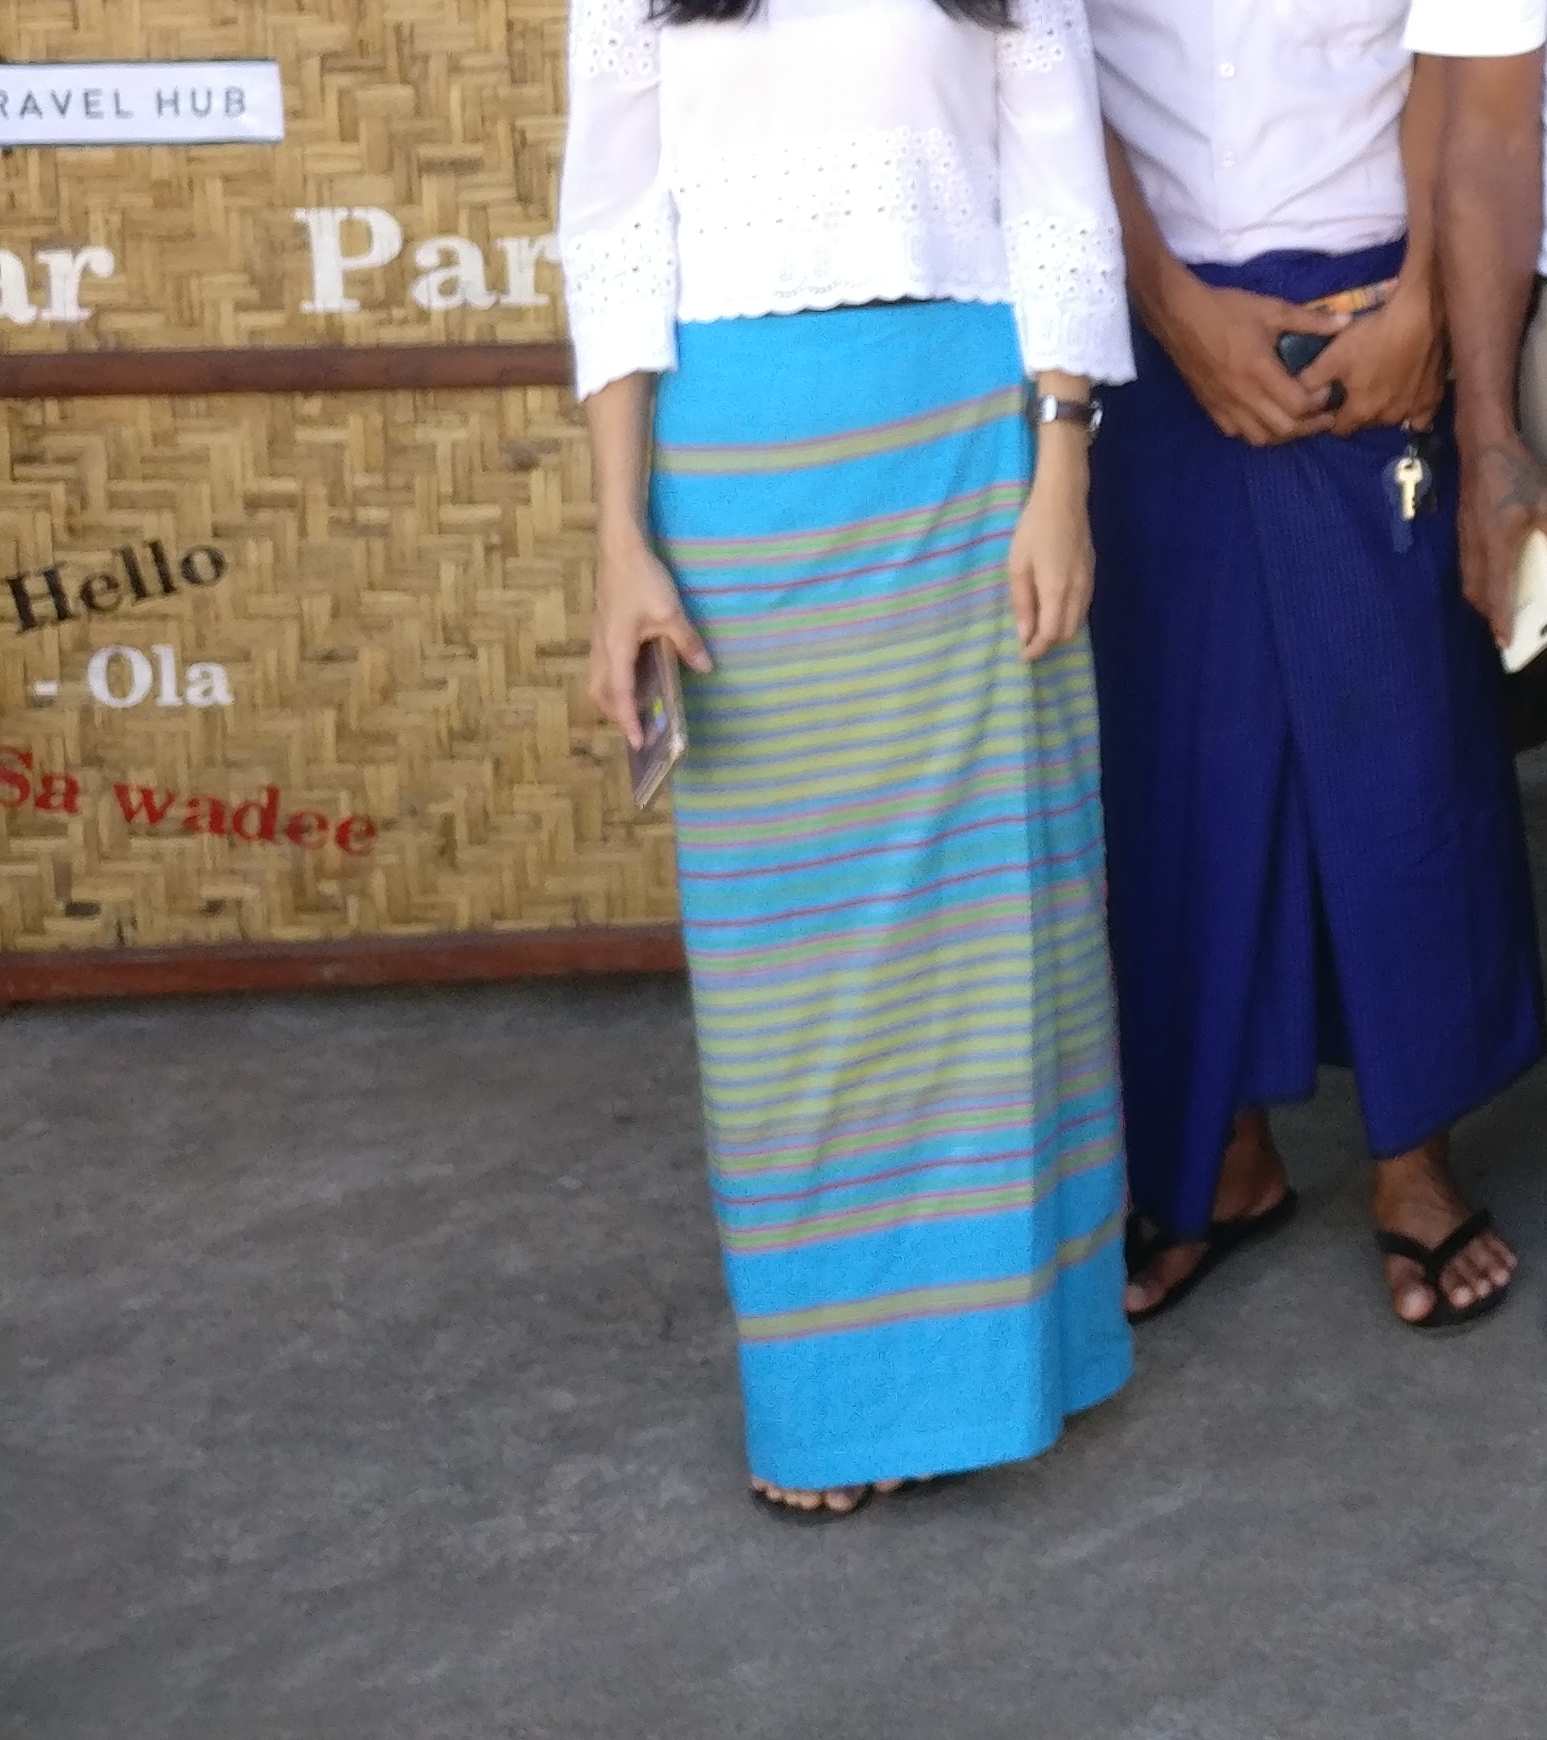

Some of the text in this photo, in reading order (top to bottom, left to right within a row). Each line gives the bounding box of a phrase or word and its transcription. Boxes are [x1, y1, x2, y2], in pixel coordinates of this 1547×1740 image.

[156, 86, 246, 119] HUB
[294, 205, 566, 314] Par
[5, 539, 228, 635] Hello
[87, 644, 235, 709] Ola
[0, 745, 379, 857] Sa wadee
